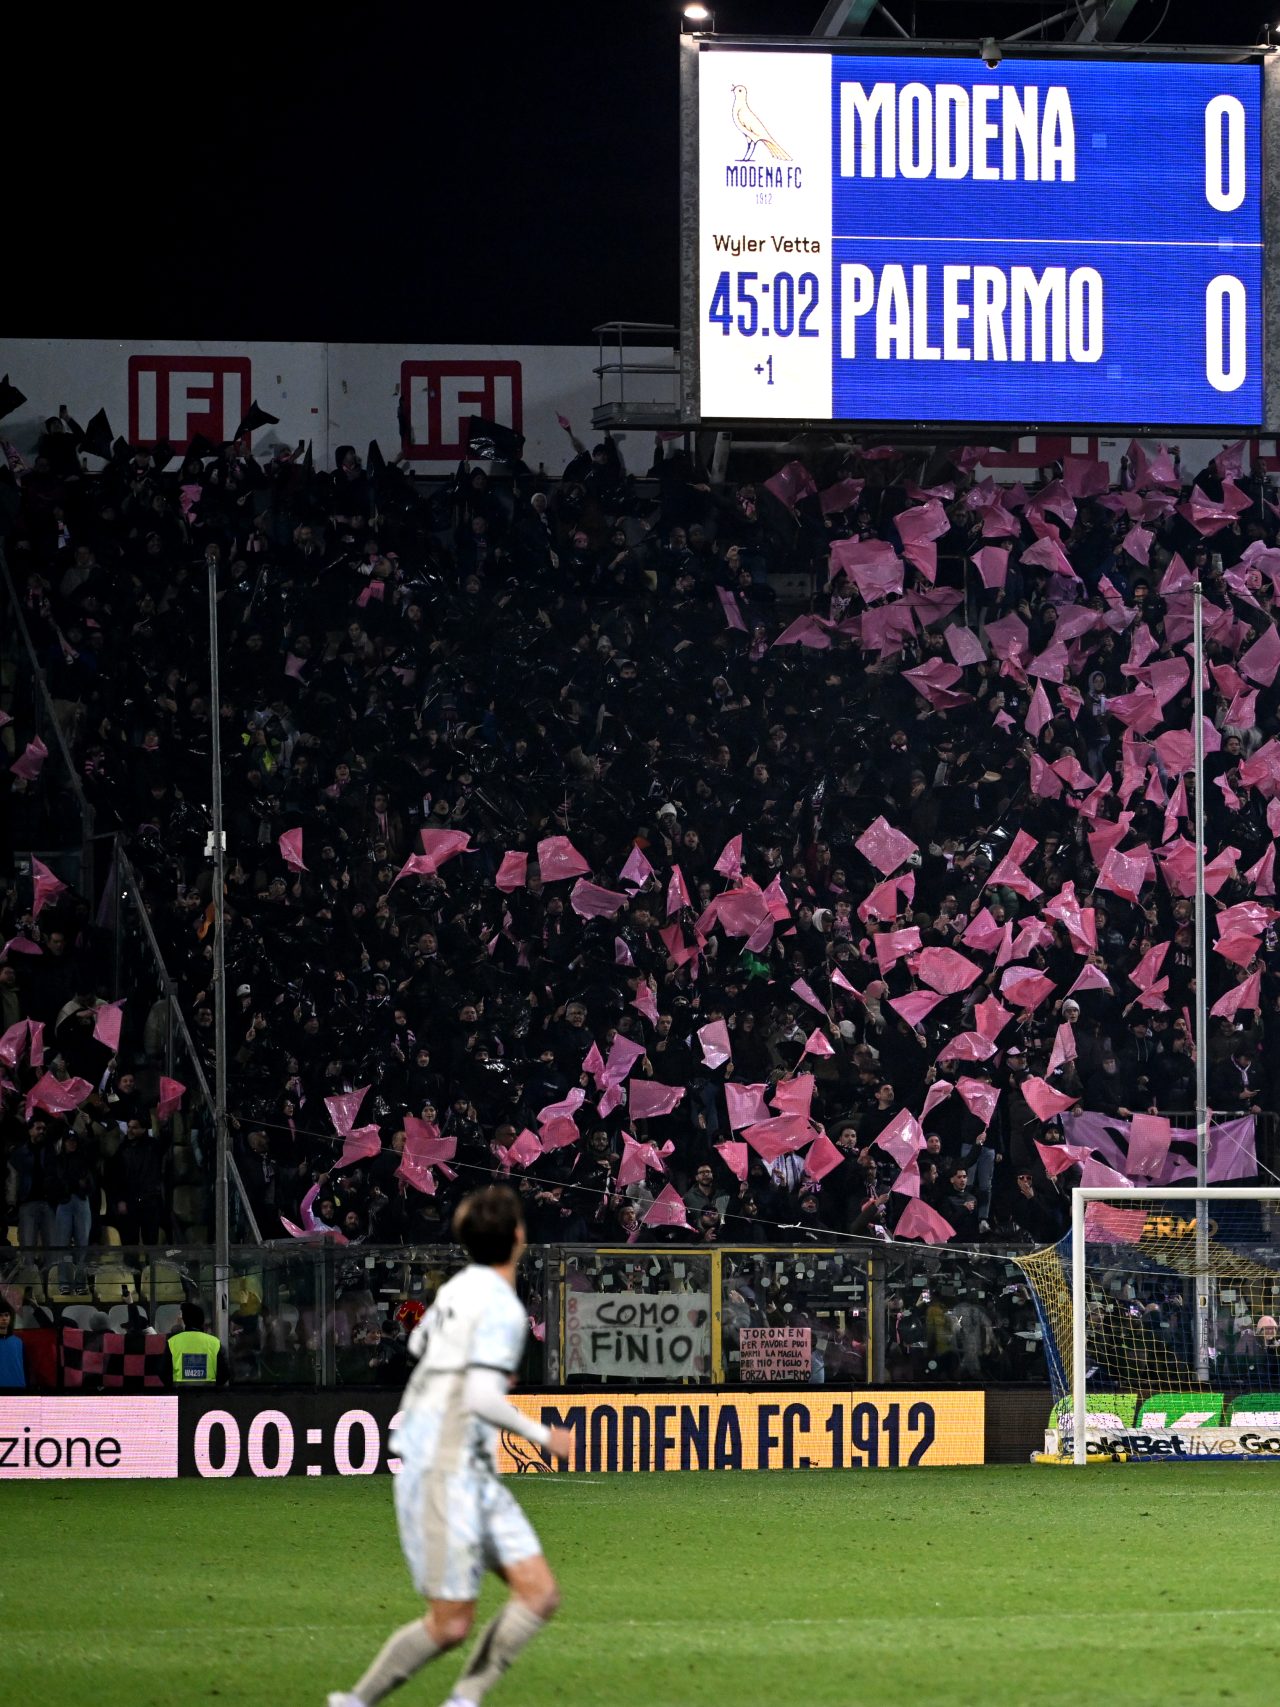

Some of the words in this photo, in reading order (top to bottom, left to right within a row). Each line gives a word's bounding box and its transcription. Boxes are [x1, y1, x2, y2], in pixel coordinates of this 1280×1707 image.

[840, 81, 1076, 182] MODENA
[1204, 94, 1246, 212] 0
[726, 165, 783, 188] MODENA
[787, 166, 802, 189] FC
[756, 192, 773, 205] 1912
[712, 234, 766, 257] Wyler
[770, 235, 821, 253] Vetta
[708, 270, 820, 338] 45:02
[840, 262, 1104, 363] PALERMO
[1204, 274, 1247, 392] 0
[754, 354, 775, 385] +1
[137, 370, 242, 442] IFI
[596, 1300, 680, 1328] COMO
[741, 1340, 757, 1350] PER
[760, 1339, 788, 1349] FAVORE
[743, 1328, 804, 1340] JORONEN
[740, 1359, 754, 1368] PER
[757, 1359, 773, 1368] MIO
[776, 1359, 802, 1368] FIGLIO
[765, 1349, 776, 1358] LA
[777, 1350, 803, 1358] MAGLIA
[740, 1369, 768, 1381] FORZA
[0, 1426, 121, 1469] zione
[540, 1403, 742, 1471] MODENA
[825, 1401, 936, 1468] 1912
